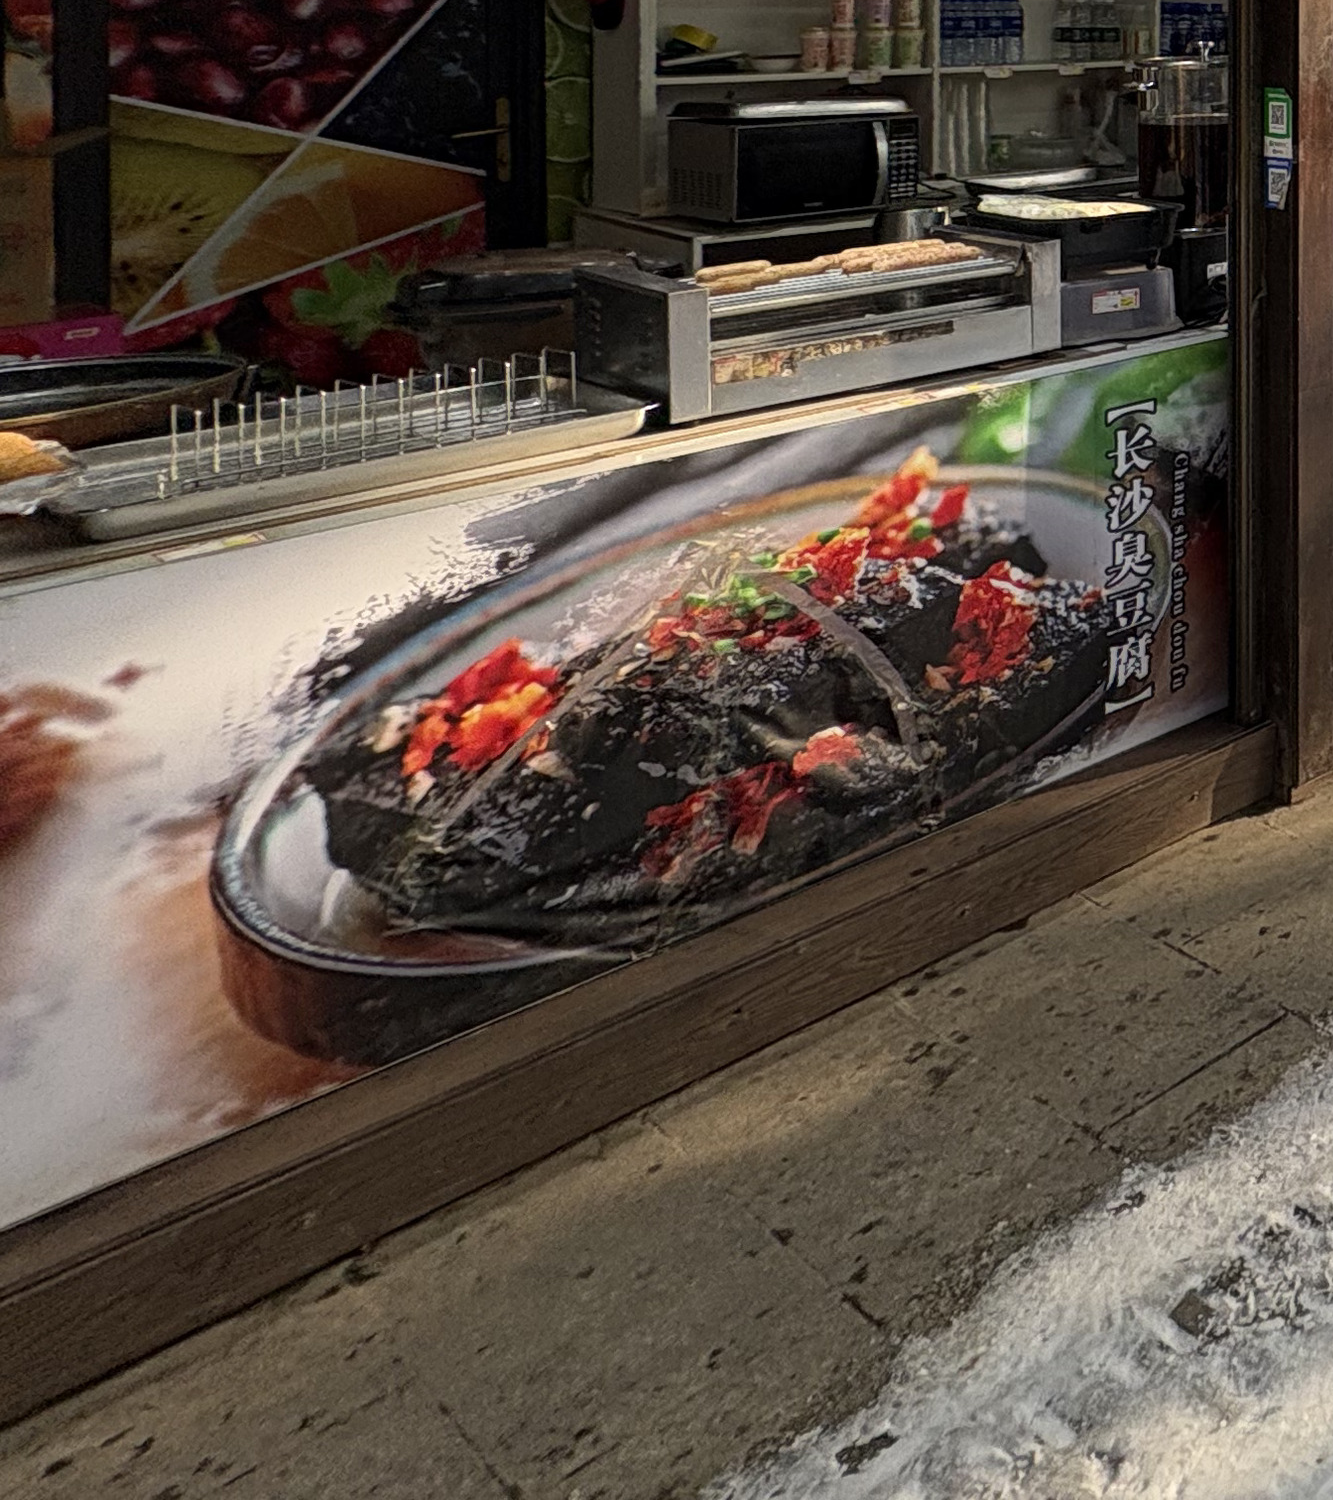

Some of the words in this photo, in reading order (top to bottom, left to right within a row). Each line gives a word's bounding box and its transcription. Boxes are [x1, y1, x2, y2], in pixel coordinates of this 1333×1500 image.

[1171, 451, 1190, 520] Chang
[1172, 524, 1189, 562] sha
[1172, 564, 1189, 617] chou
[1172, 622, 1189, 664] dou
[1172, 666, 1189, 692] fu
